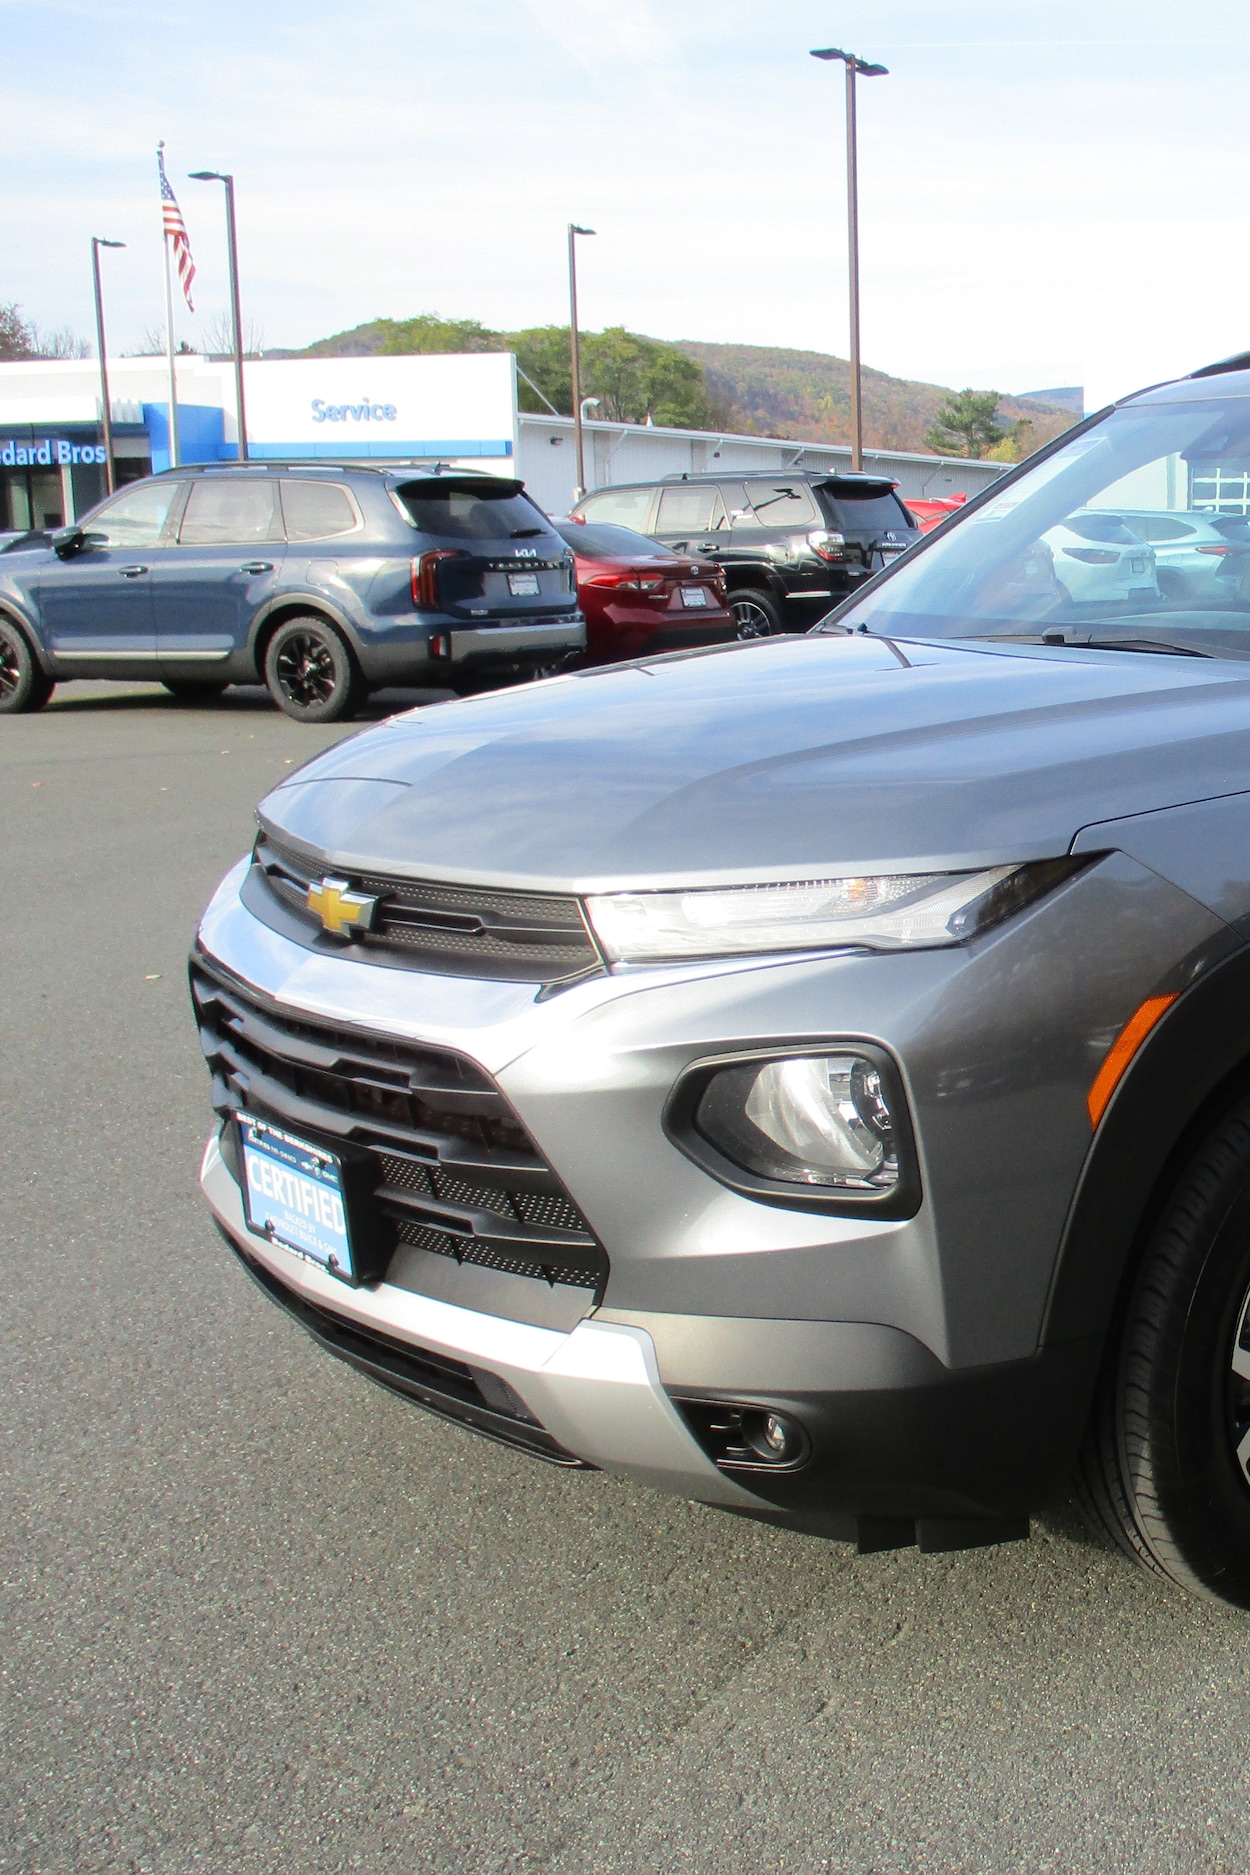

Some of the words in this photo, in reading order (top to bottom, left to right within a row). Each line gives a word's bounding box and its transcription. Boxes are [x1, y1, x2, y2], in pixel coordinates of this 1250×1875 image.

[311, 396, 398, 423] Service
[0, 440, 52, 466] dard
[57, 440, 107, 464] Bros
[248, 1154, 347, 1236] CERTIFIED
